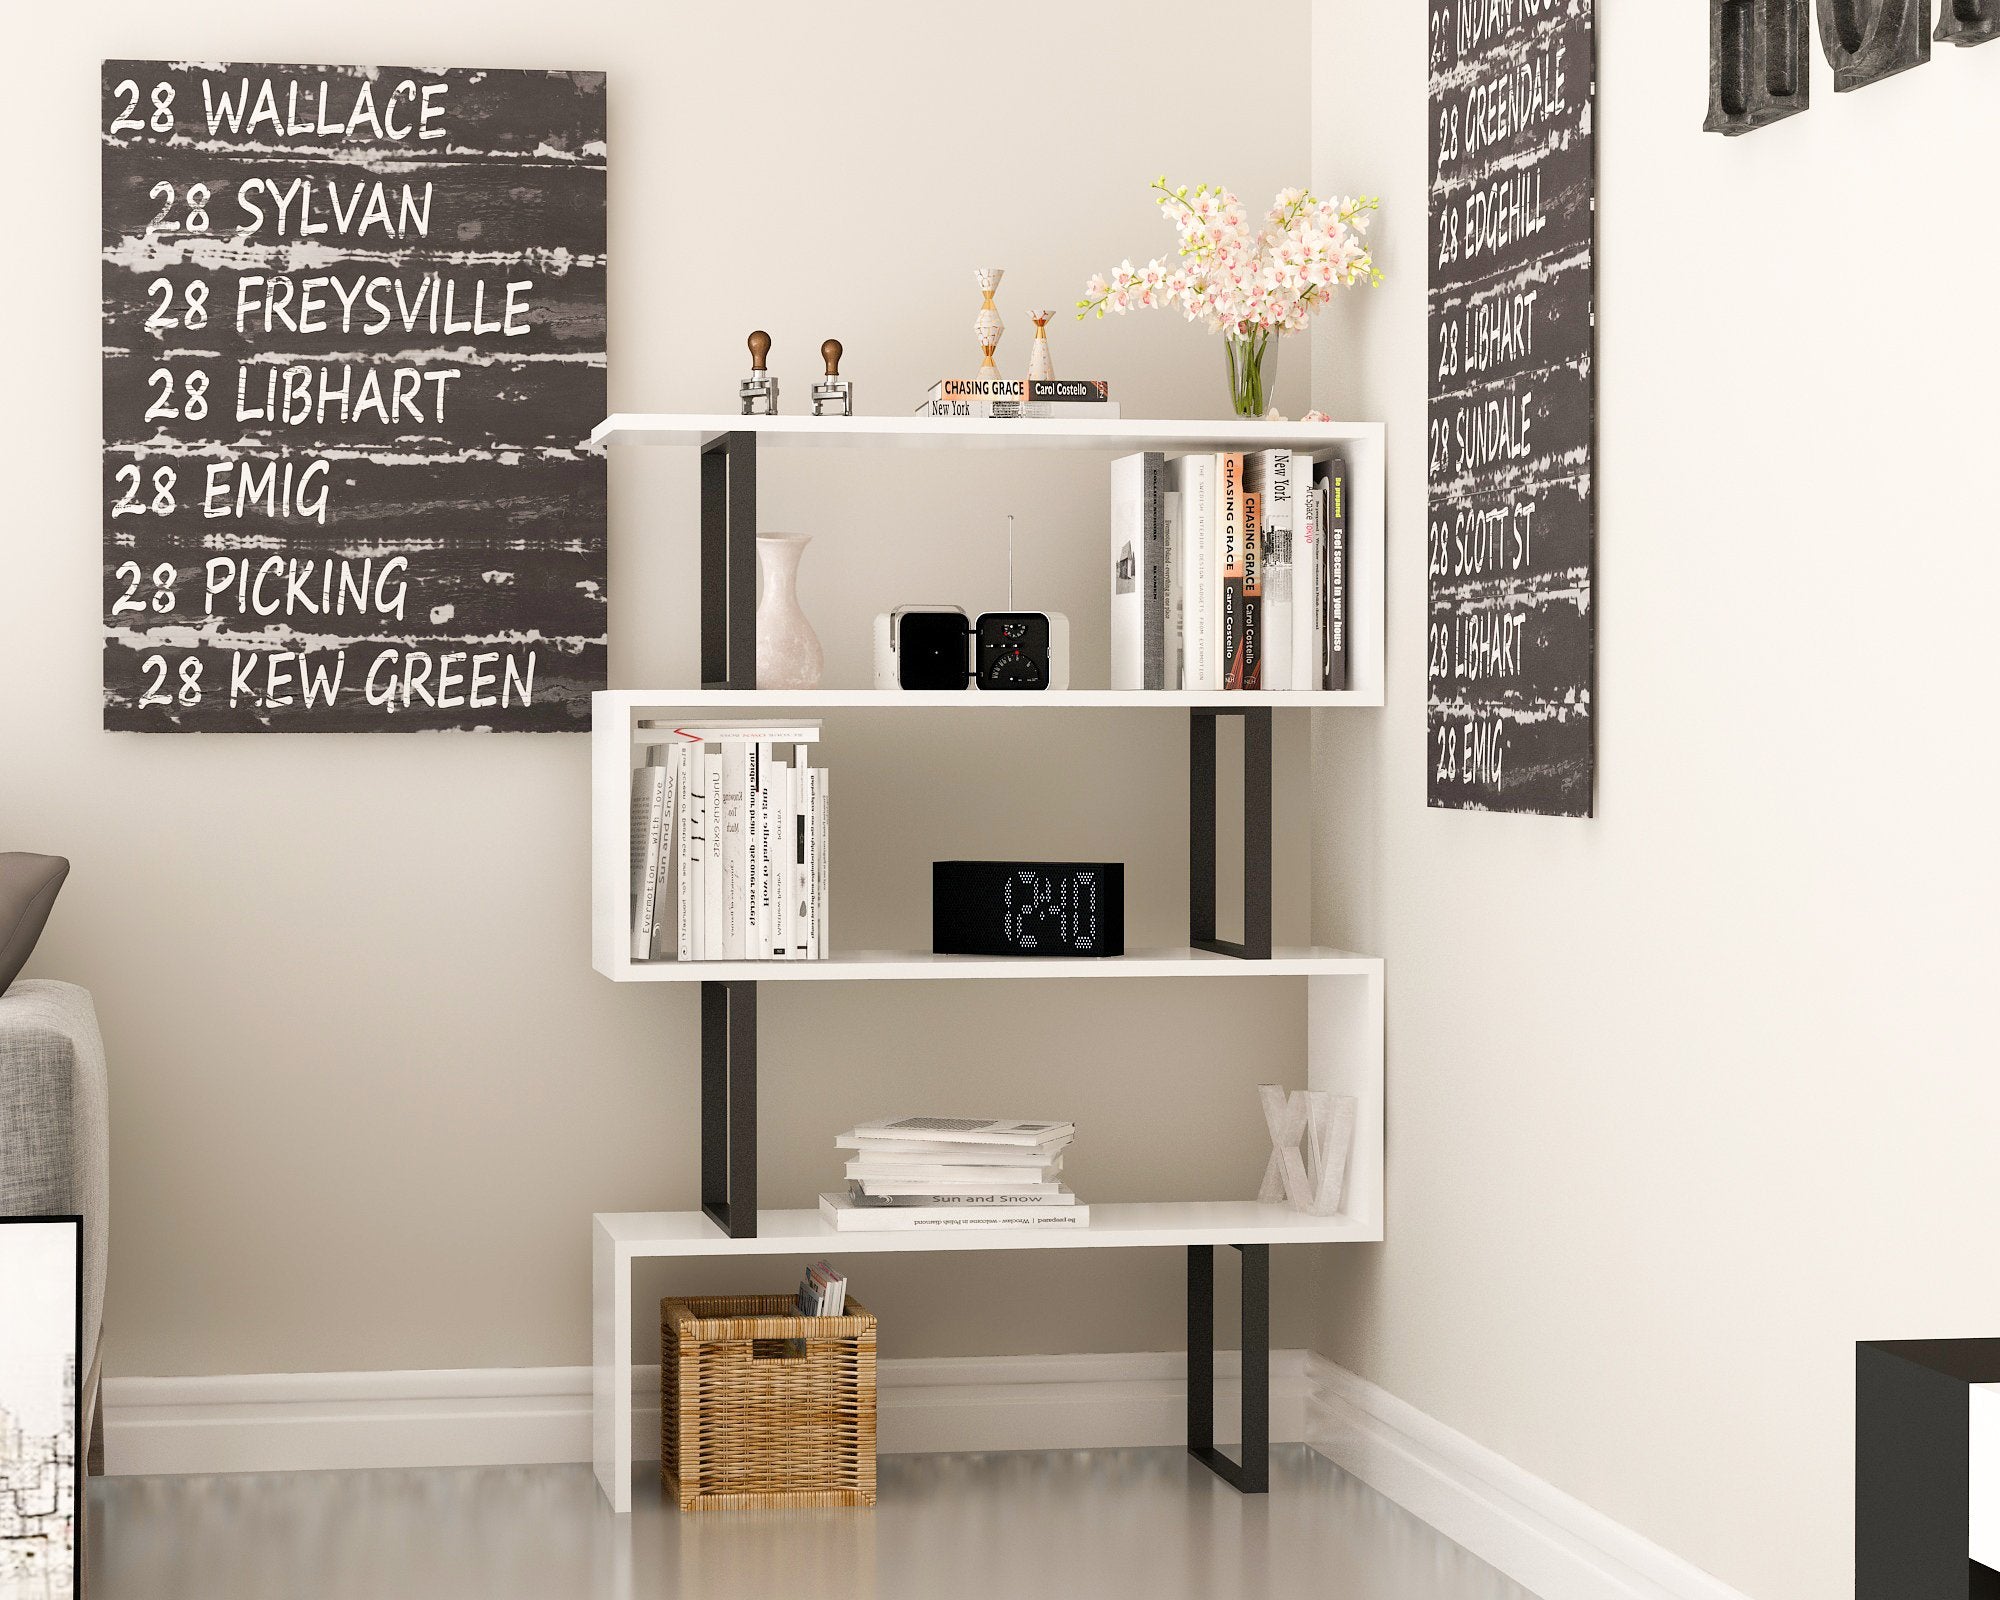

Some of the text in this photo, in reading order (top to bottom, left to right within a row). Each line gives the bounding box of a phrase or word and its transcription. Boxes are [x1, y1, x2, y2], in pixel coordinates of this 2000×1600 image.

[110, 78, 448, 140] 28 WALLACE
[1438, 47, 1566, 168] 28 GREENDALE
[146, 178, 433, 239] 28 SYLVAN
[1438, 168, 1546, 271] 28 EDGEHILL
[145, 275, 533, 337] 28 FREYSVILLE
[1438, 290, 1537, 382] 28 LIBHART
[145, 365, 461, 425] 28 LIBHART
[932, 401, 970, 416] New York
[945, 381, 989, 396] CHASING
[992, 381, 1024, 396] GRACE
[1035, 382, 1055, 396] Carol
[1056, 382, 1087, 396] Costello
[1430, 392, 1532, 477] 28 SUNDALE
[112, 460, 330, 525] 28 EMIG
[1275, 455, 1291, 502] New York
[1305, 499, 1313, 520] Space
[1334, 478, 1341, 486] Be
[1226, 459, 1234, 659] CHASING GRACE Carol Costello
[1334, 529, 1342, 548] Feel
[1334, 550, 1342, 585] secure
[1429, 502, 1535, 580] 28 SCOTT ST
[112, 556, 408, 621] 28 PICKING
[1246, 498, 1255, 664] CHASING GRACE Carol Costello
[1333, 597, 1342, 620] your
[1334, 621, 1342, 651] house
[1429, 611, 1525, 681] 28 LIBHART
[139, 649, 536, 714] 28 KEW GREEN
[1437, 718, 1503, 792] 28 EMIG
[658, 776, 673, 884] Sun and Snow
[643, 865, 655, 934] Evermotion
[651, 817, 659, 845] with
[933, 1194, 1043, 1203] Sun and Snow
